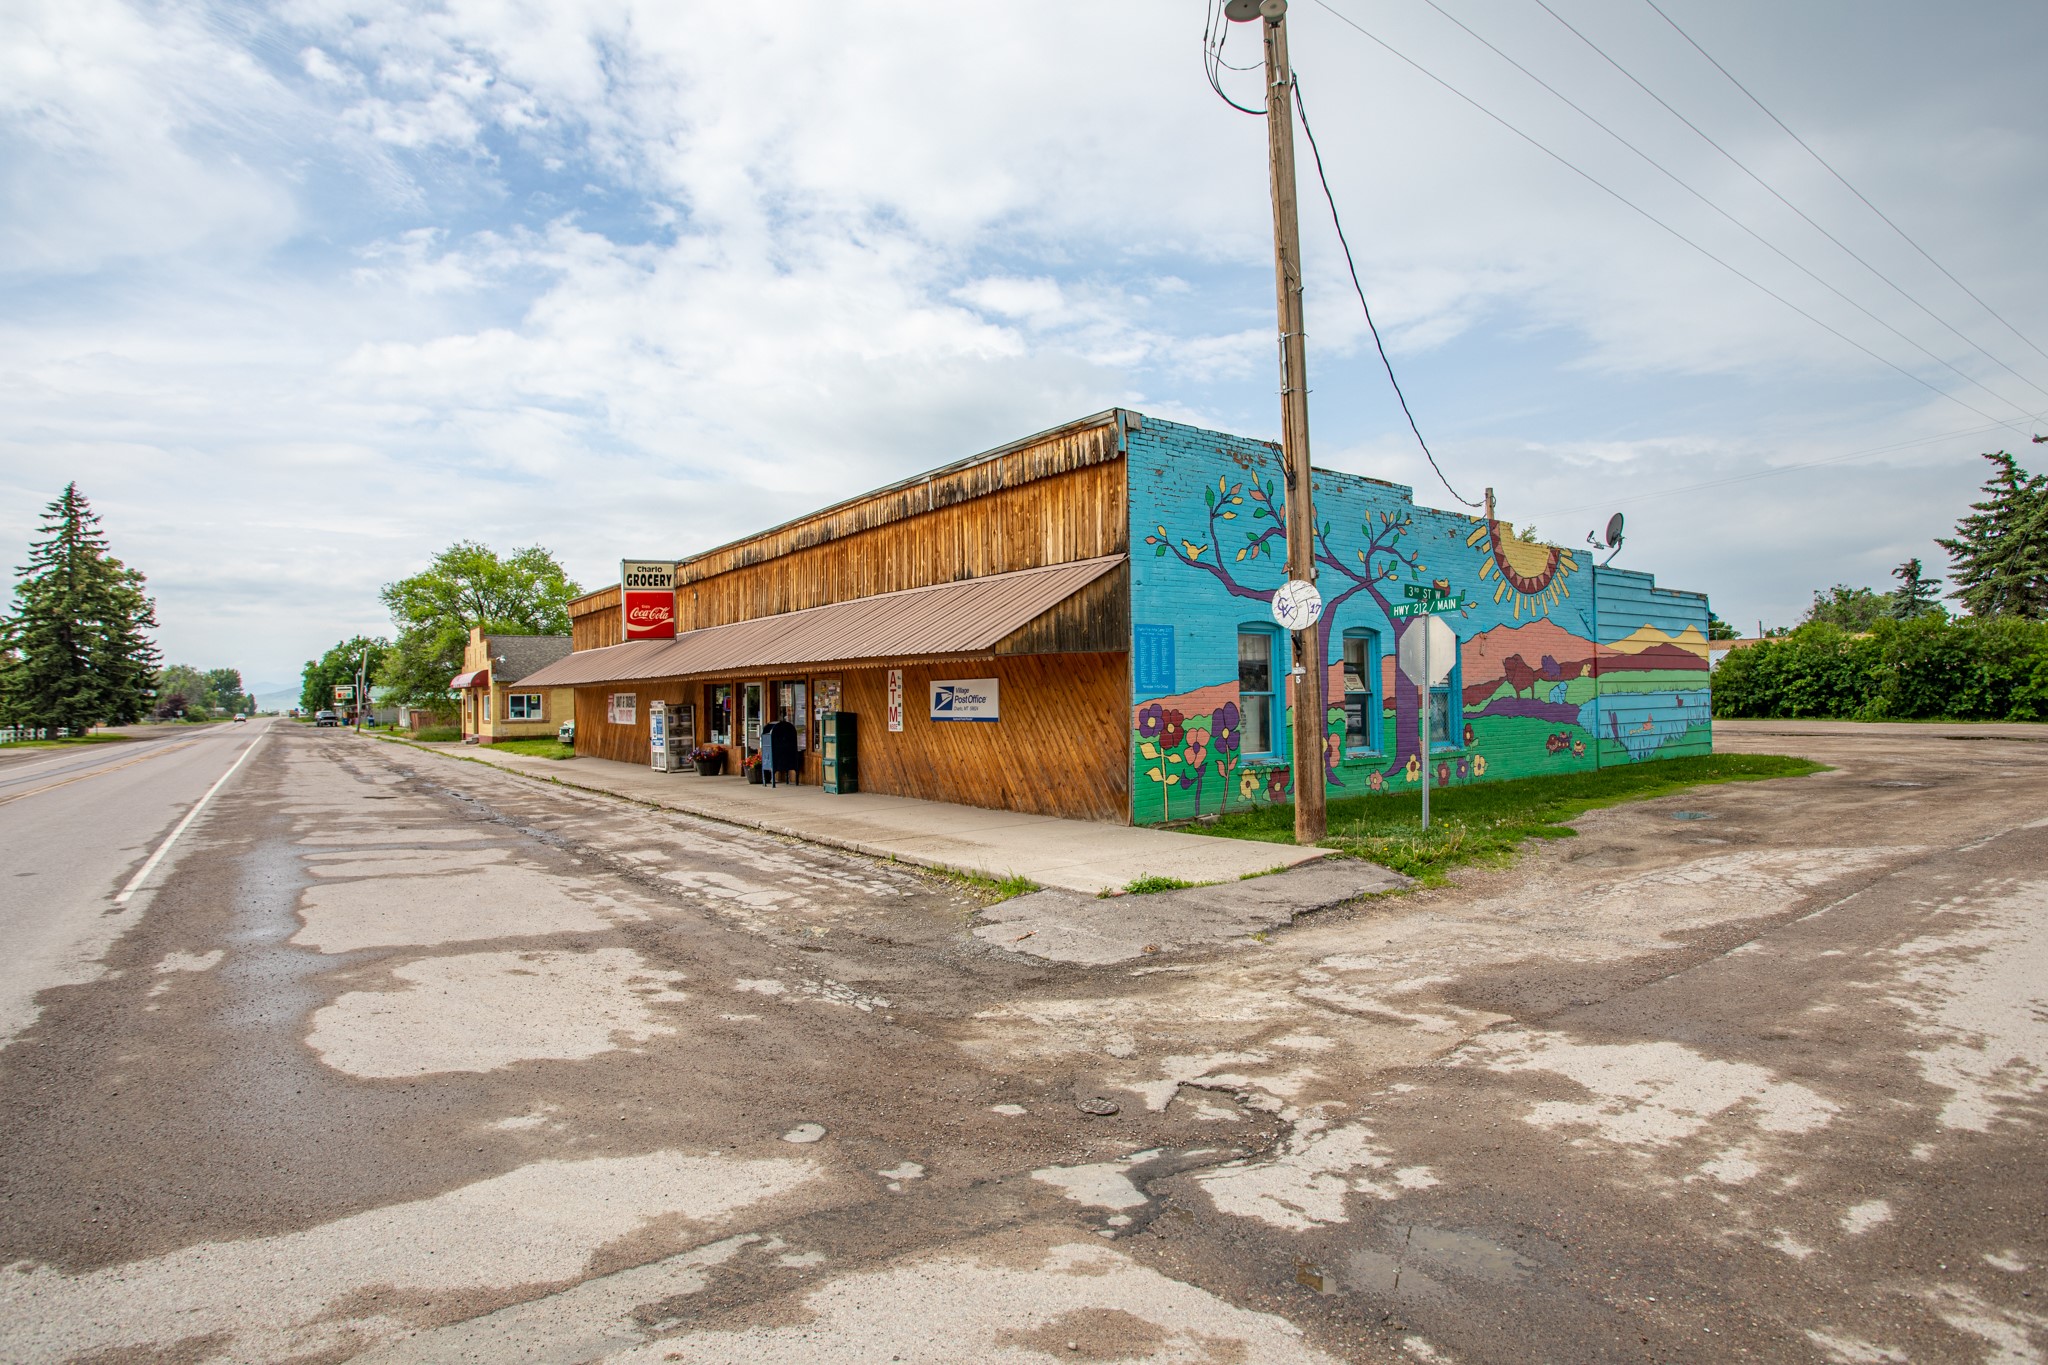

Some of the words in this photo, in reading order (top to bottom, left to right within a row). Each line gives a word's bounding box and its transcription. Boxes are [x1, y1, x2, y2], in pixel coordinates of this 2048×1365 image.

[627, 573, 672, 586] GROCERY
[1422, 589, 1432, 599] ST
[1435, 591, 1441, 599] W
[630, 607, 670, 619] Coca-Cola
[1393, 604, 1410, 616] HWY
[1413, 602, 1428, 613] 212
[1437, 599, 1456, 611] MAIN
[889, 671, 898, 723] ATM
